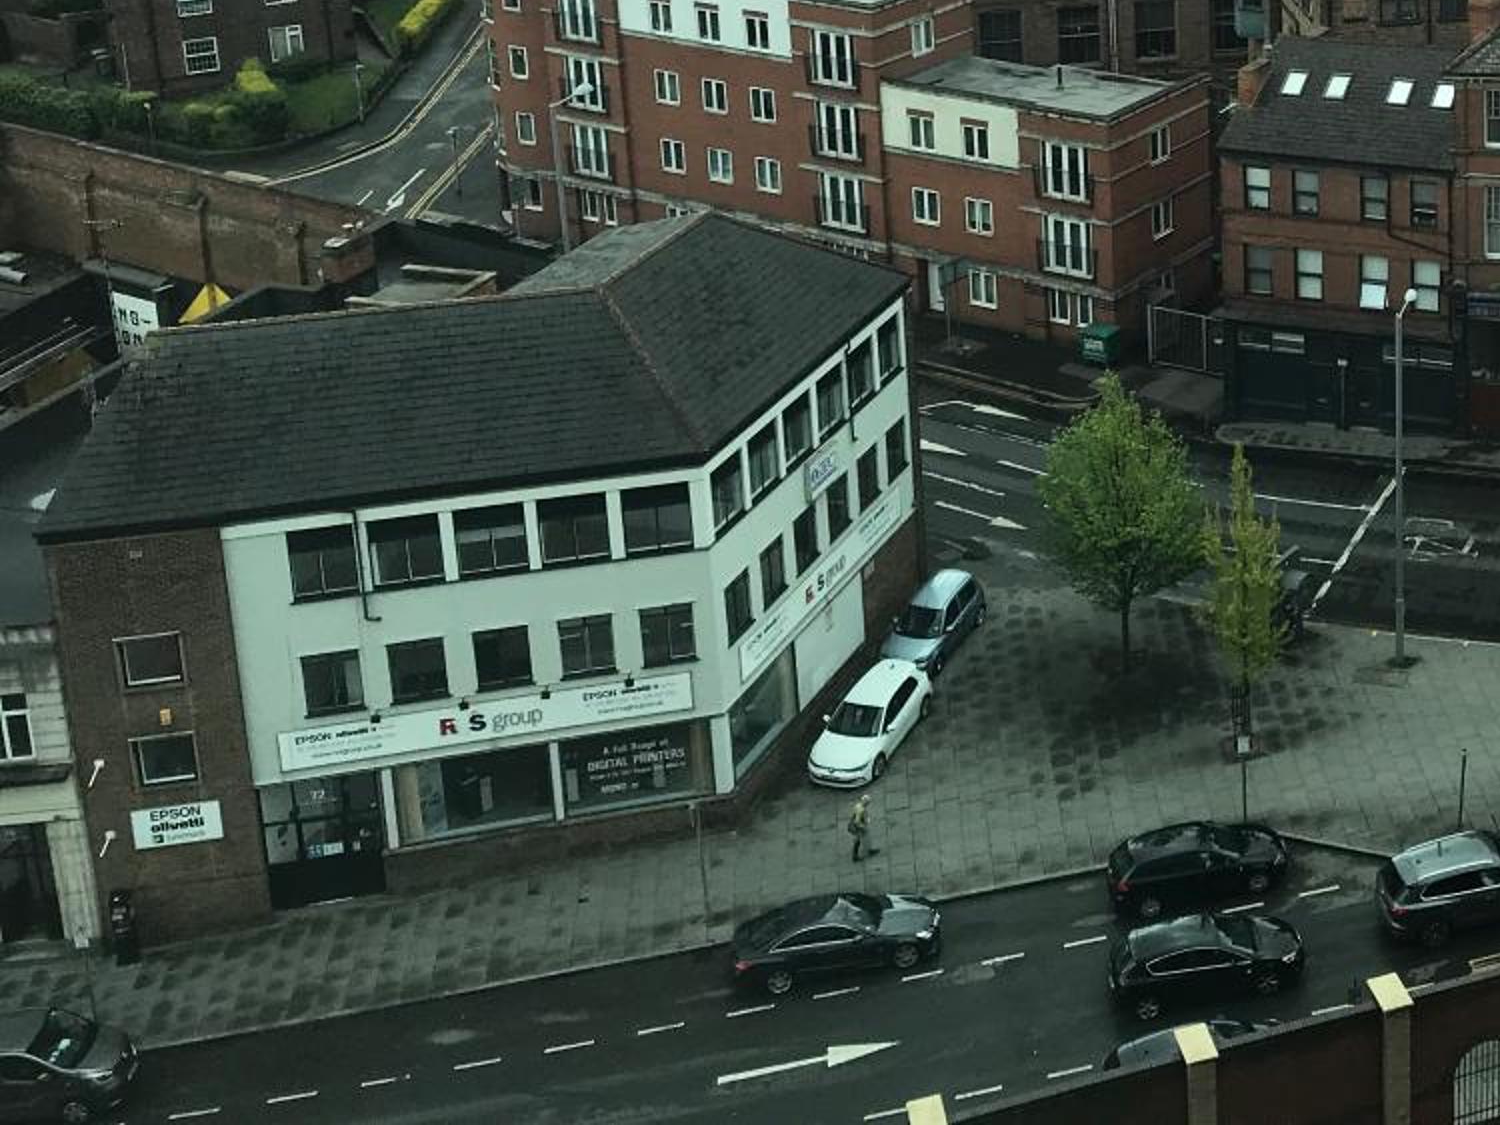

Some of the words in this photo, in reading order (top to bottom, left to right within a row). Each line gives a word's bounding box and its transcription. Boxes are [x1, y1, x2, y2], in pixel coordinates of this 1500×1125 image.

[491, 708, 543, 734] group
[149, 805, 201, 822] EPSON
[151, 817, 205, 833] olivetti
